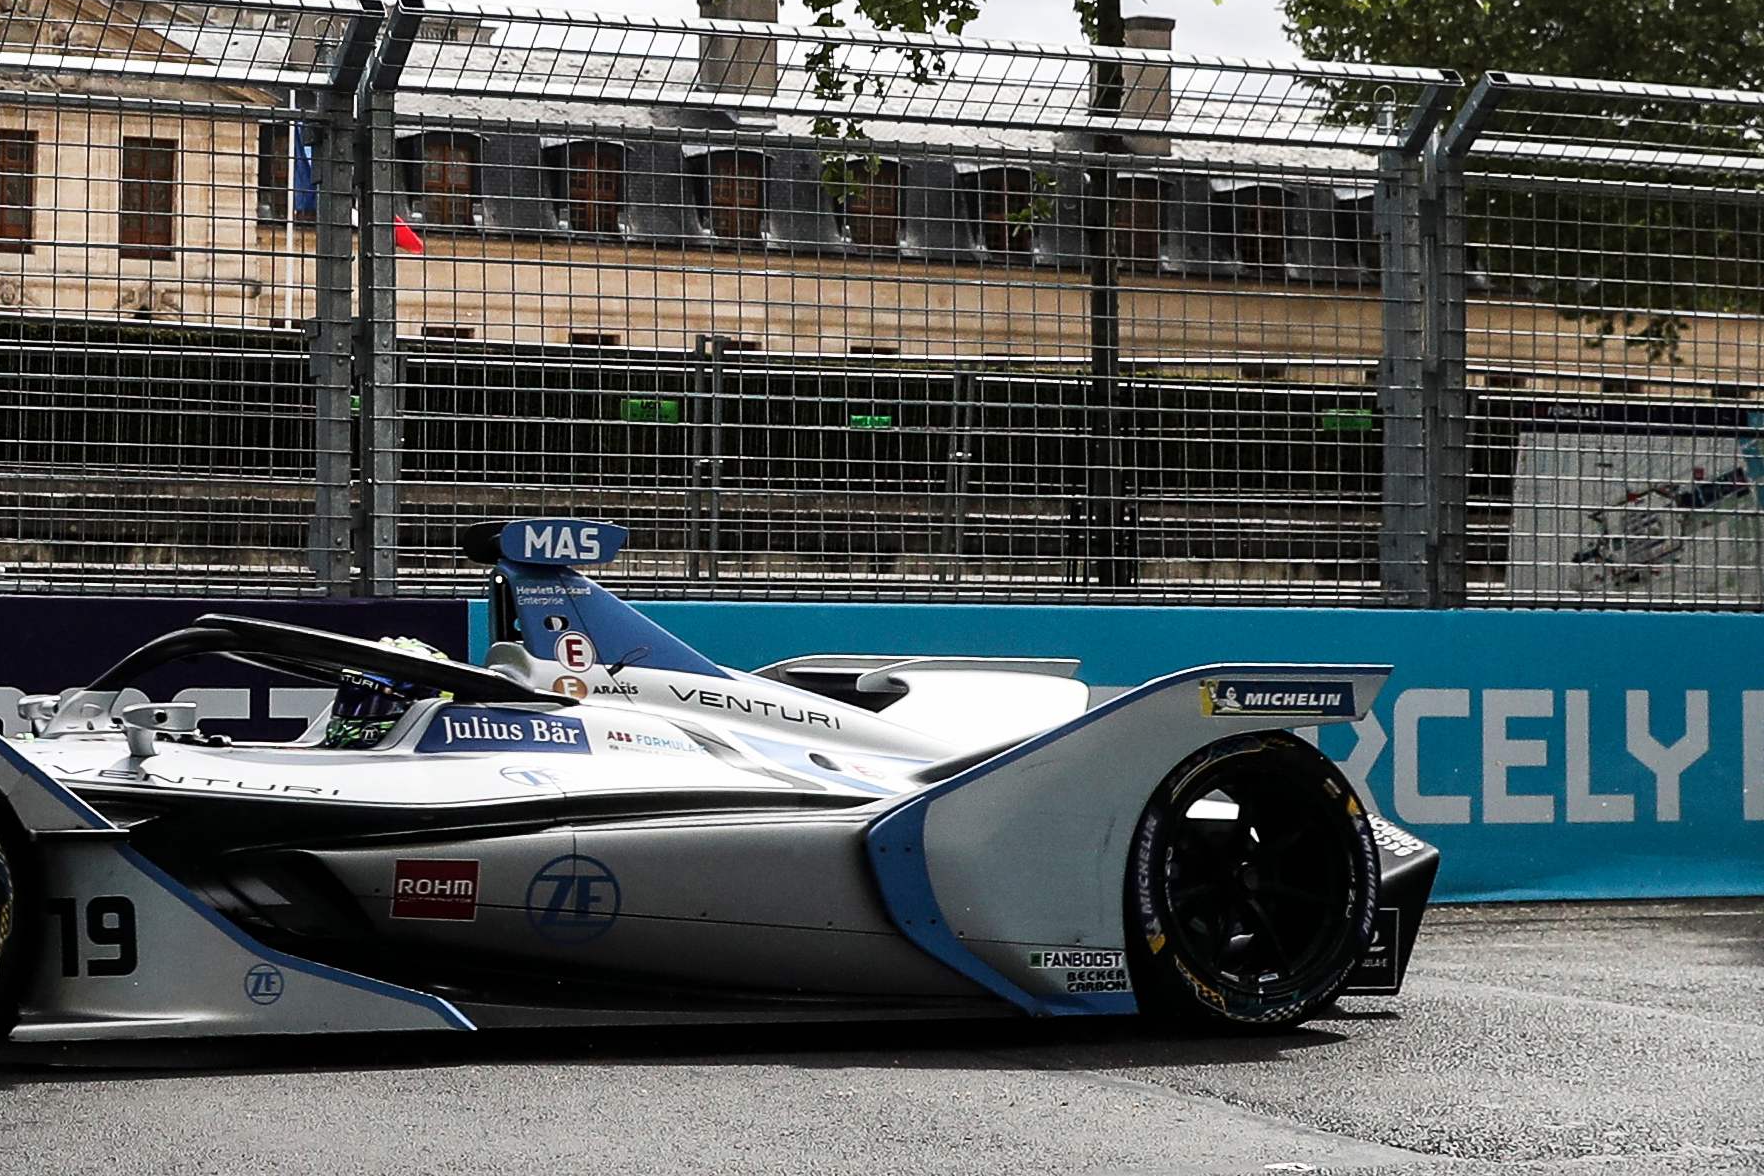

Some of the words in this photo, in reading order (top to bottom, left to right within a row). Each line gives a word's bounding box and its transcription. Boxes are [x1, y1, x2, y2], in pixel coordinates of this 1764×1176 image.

[525, 526, 600, 560] MAS
[516, 587, 553, 595] Hewlett
[517, 597, 564, 606] Enterprise
[565, 639, 585, 667] E
[668, 684, 841, 730] VENTURI
[1244, 693, 1342, 706] MICHELIN
[442, 716, 523, 744] Julius
[532, 720, 580, 744] Bär
[607, 730, 633, 743] ABB
[52, 764, 341, 797] VENTURI
[1138, 813, 1157, 915] MICHELIN
[397, 878, 474, 895] ROHM
[534, 872, 617, 930] ZF
[48, 896, 138, 977] 19
[1044, 952, 1123, 967] FANBOOST
[247, 971, 281, 997] ZF
[1067, 970, 1126, 982] BECKER
[1067, 981, 1127, 993] CARBON
